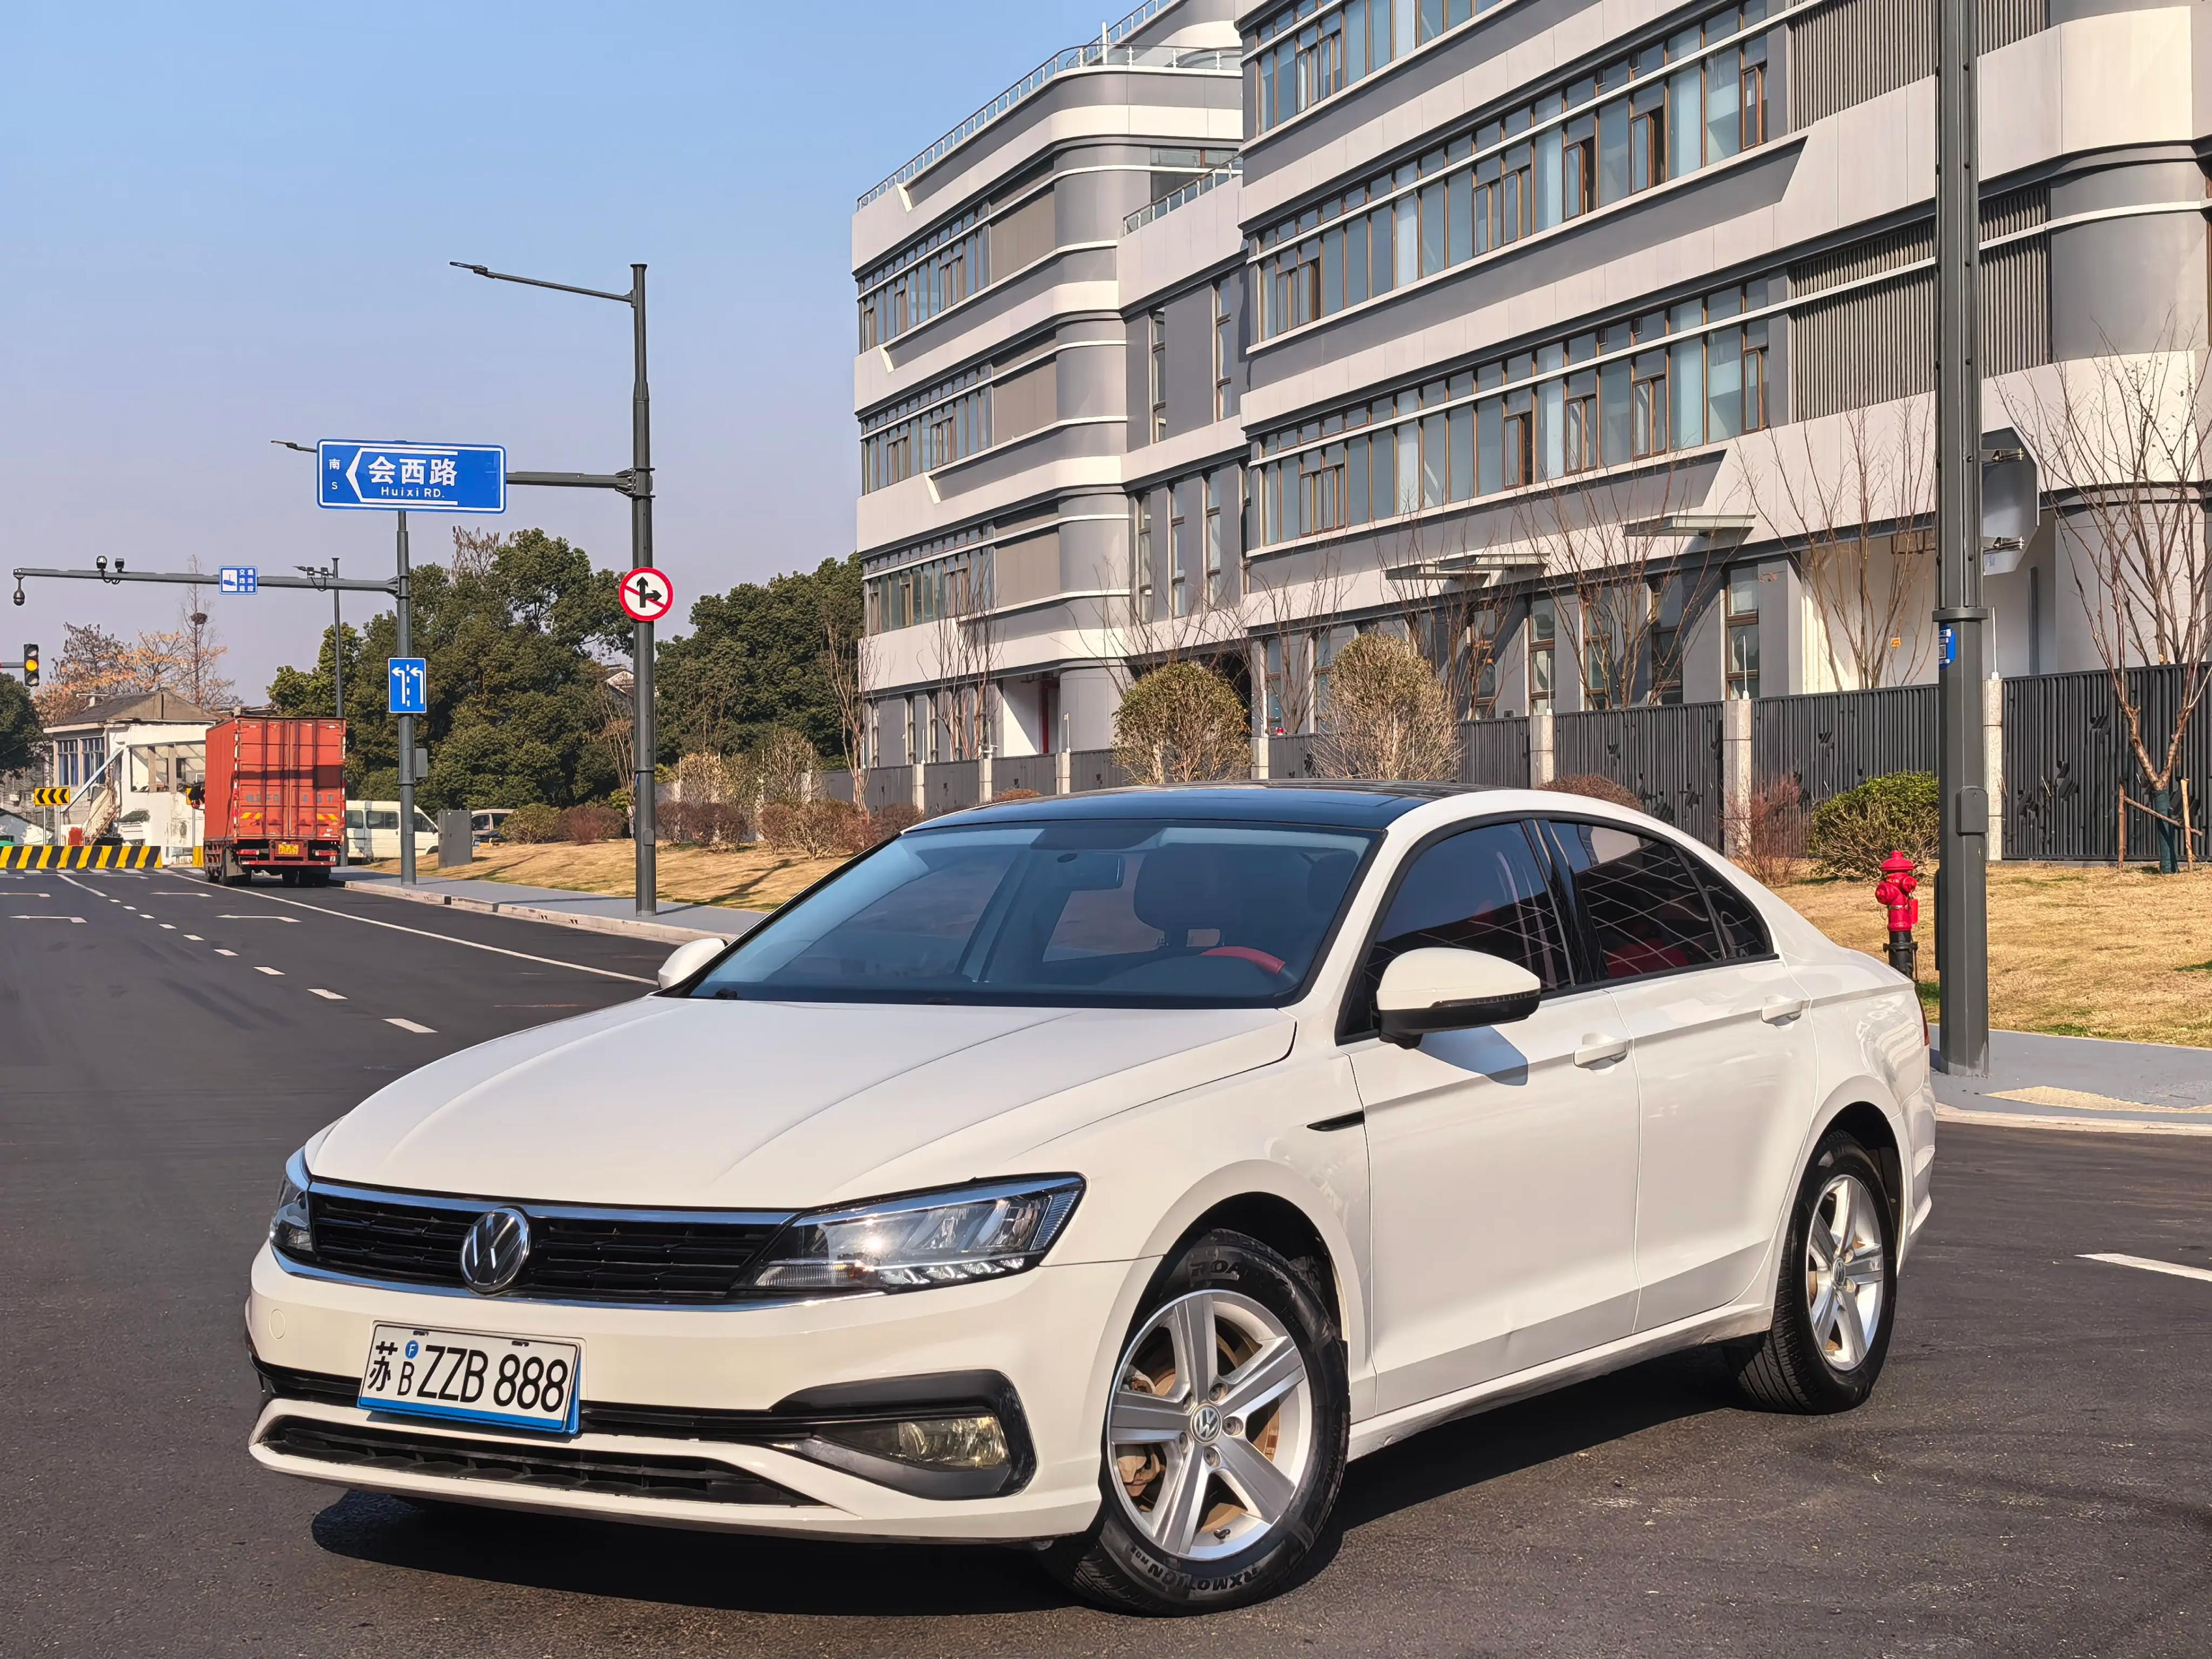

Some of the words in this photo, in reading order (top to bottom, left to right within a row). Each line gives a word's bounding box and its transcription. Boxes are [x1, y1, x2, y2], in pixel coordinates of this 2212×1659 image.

[328, 458, 341, 470] 南
[368, 455, 458, 487] 会西路
[331, 482, 338, 490] S
[381, 486, 419, 497] Huixi
[424, 488, 445, 498] RD.
